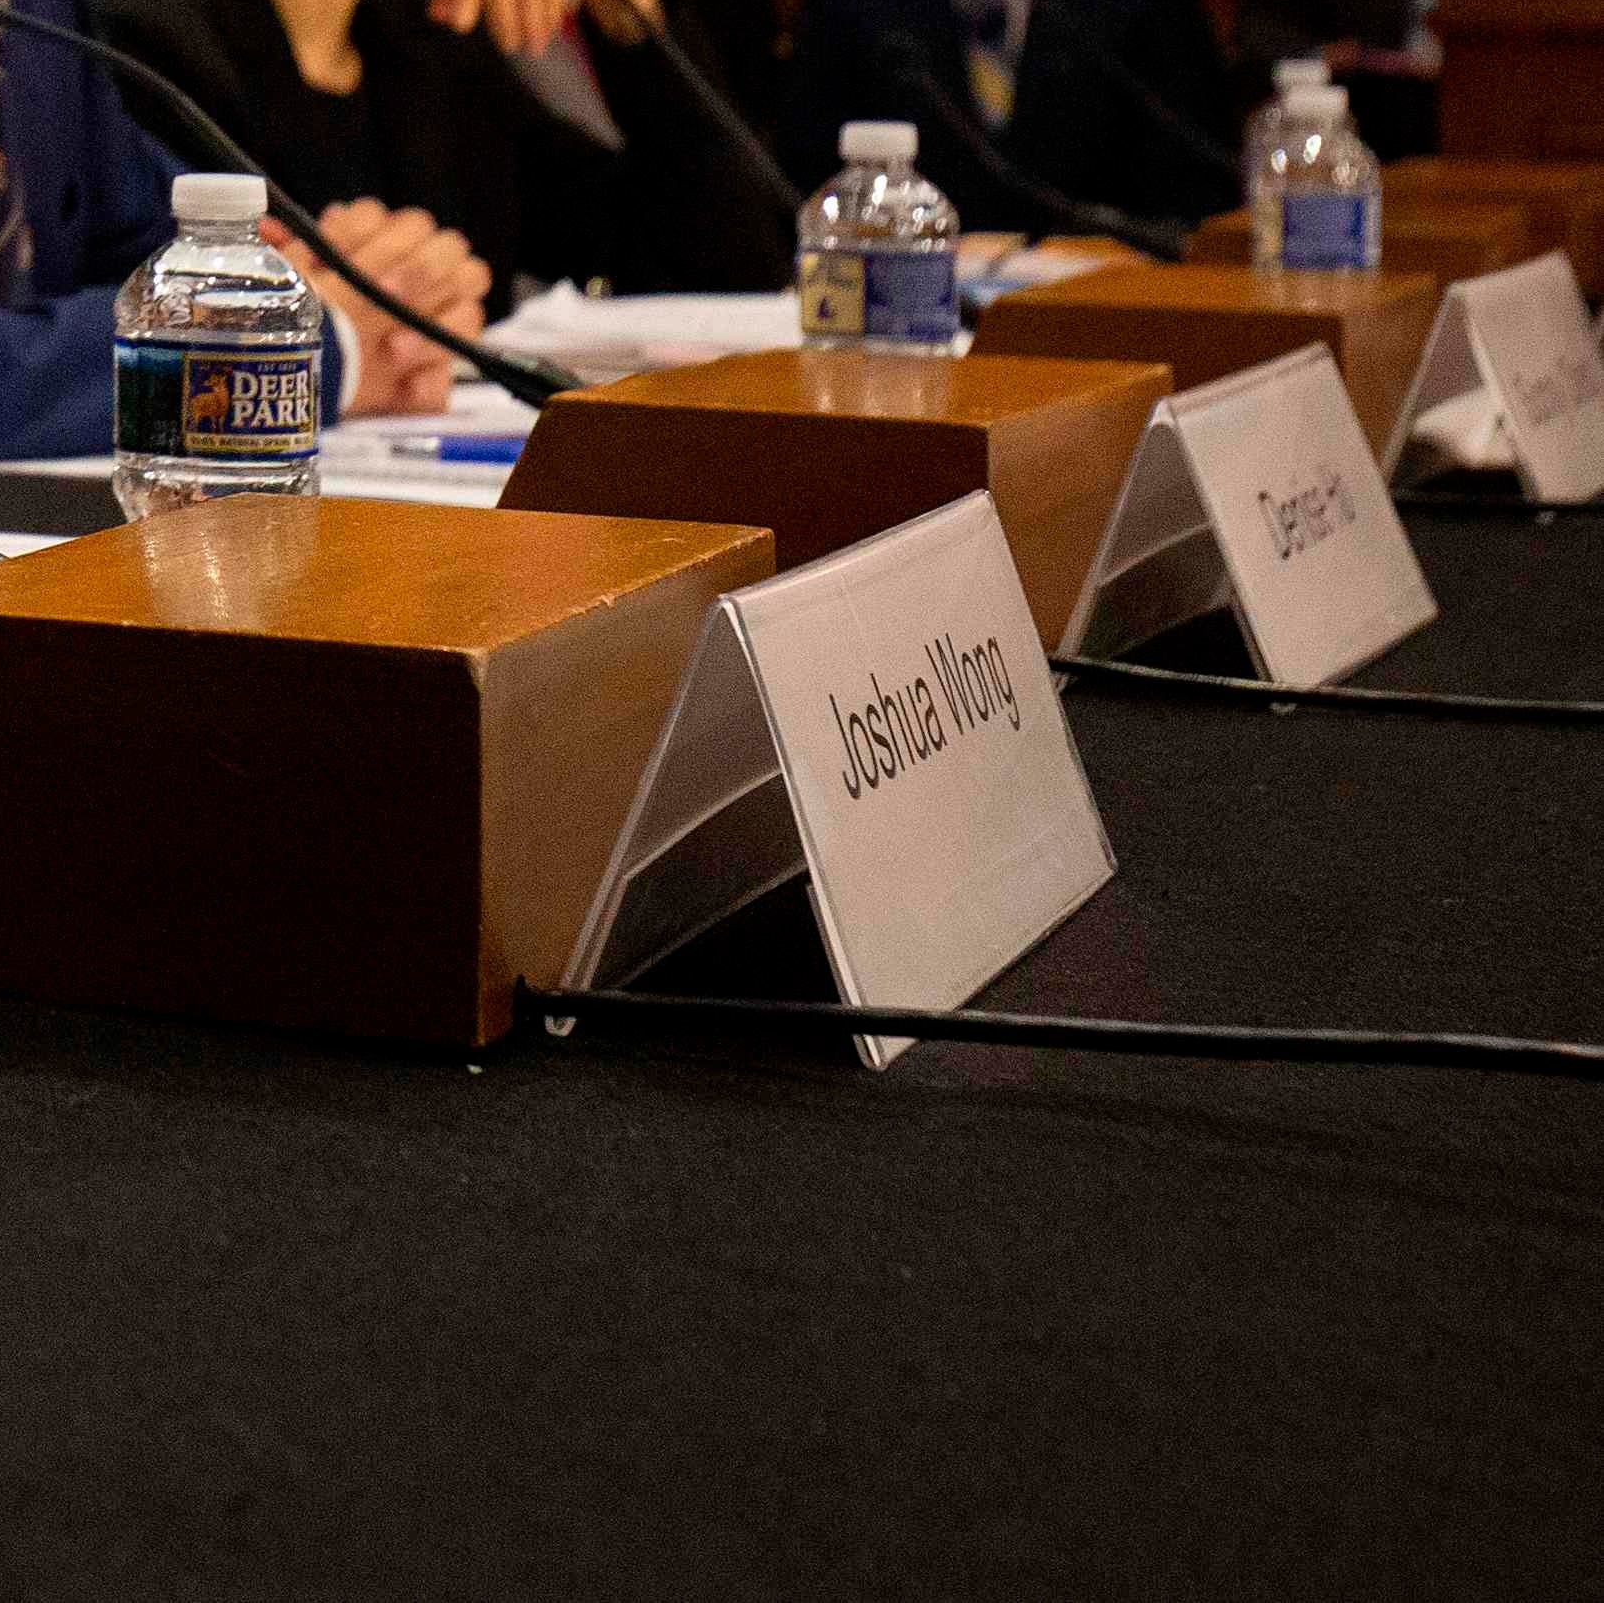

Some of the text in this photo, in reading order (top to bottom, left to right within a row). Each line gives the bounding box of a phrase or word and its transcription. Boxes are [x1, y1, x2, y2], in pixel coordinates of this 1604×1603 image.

[232, 370, 309, 398] DEER
[231, 397, 310, 427] PARK
[829, 632, 1021, 800] Joshua Wong
